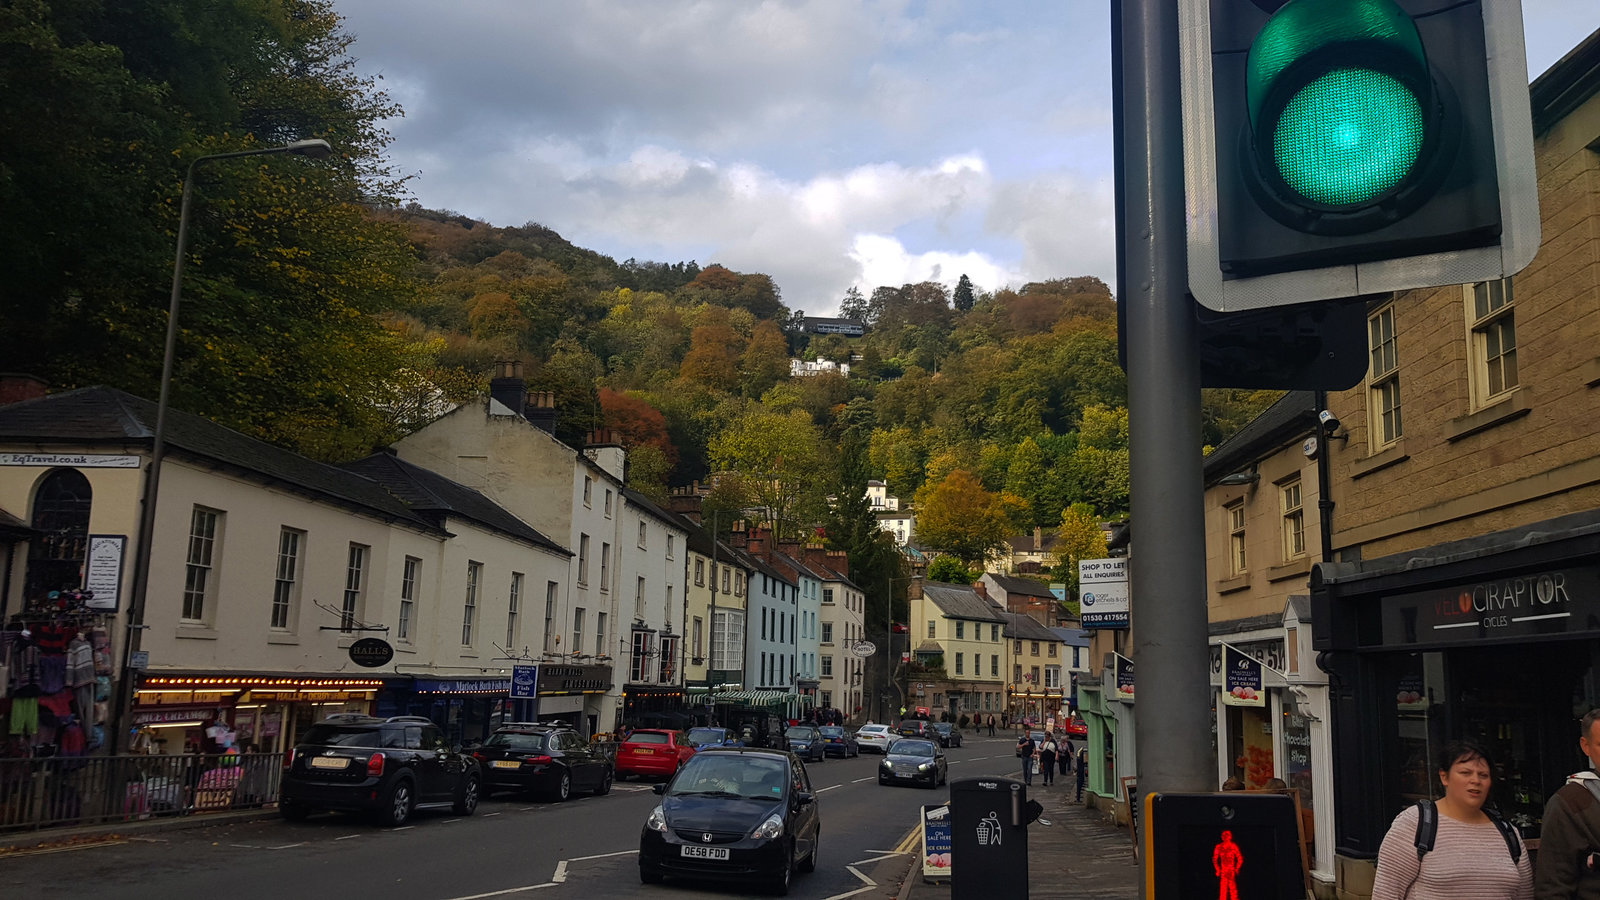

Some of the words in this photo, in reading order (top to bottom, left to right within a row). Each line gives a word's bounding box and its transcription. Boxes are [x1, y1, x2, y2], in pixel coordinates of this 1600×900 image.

[12, 454, 87, 465] EqTravel.co.uk
[1081, 563, 1100, 571] SHOP
[1434, 572, 1570, 616] VELOCIRAPTOR
[1483, 615, 1508, 628] CYCLES
[456, 681, 479, 691] Matlock
[1291, 750, 1307, 766] Shop
[684, 846, 707, 857] OE58
[708, 848, 726, 858] FDD
